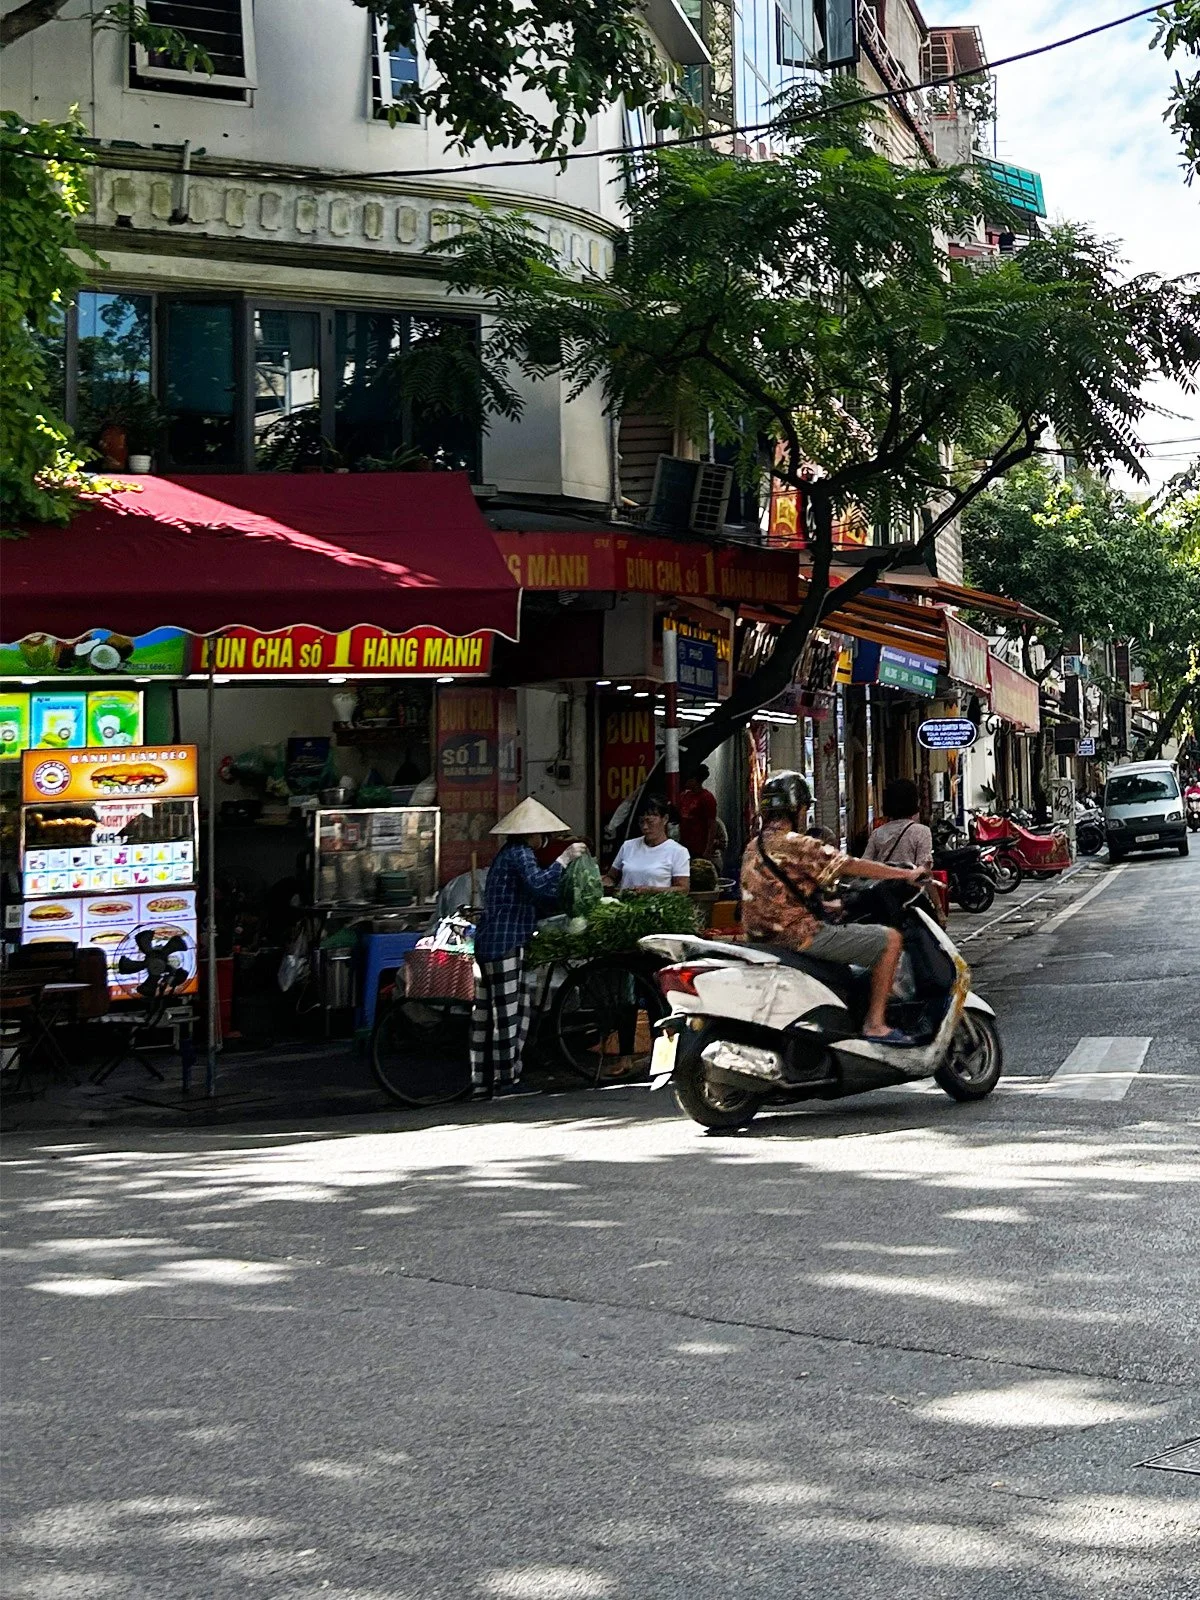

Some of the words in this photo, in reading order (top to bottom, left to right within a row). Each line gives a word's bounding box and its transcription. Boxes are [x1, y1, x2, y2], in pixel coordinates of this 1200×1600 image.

[527, 547, 590, 587] MÀNH
[626, 551, 654, 590] BÚN
[703, 550, 720, 595] 1
[327, 630, 355, 668] 1
[473, 738, 489, 764] 1
